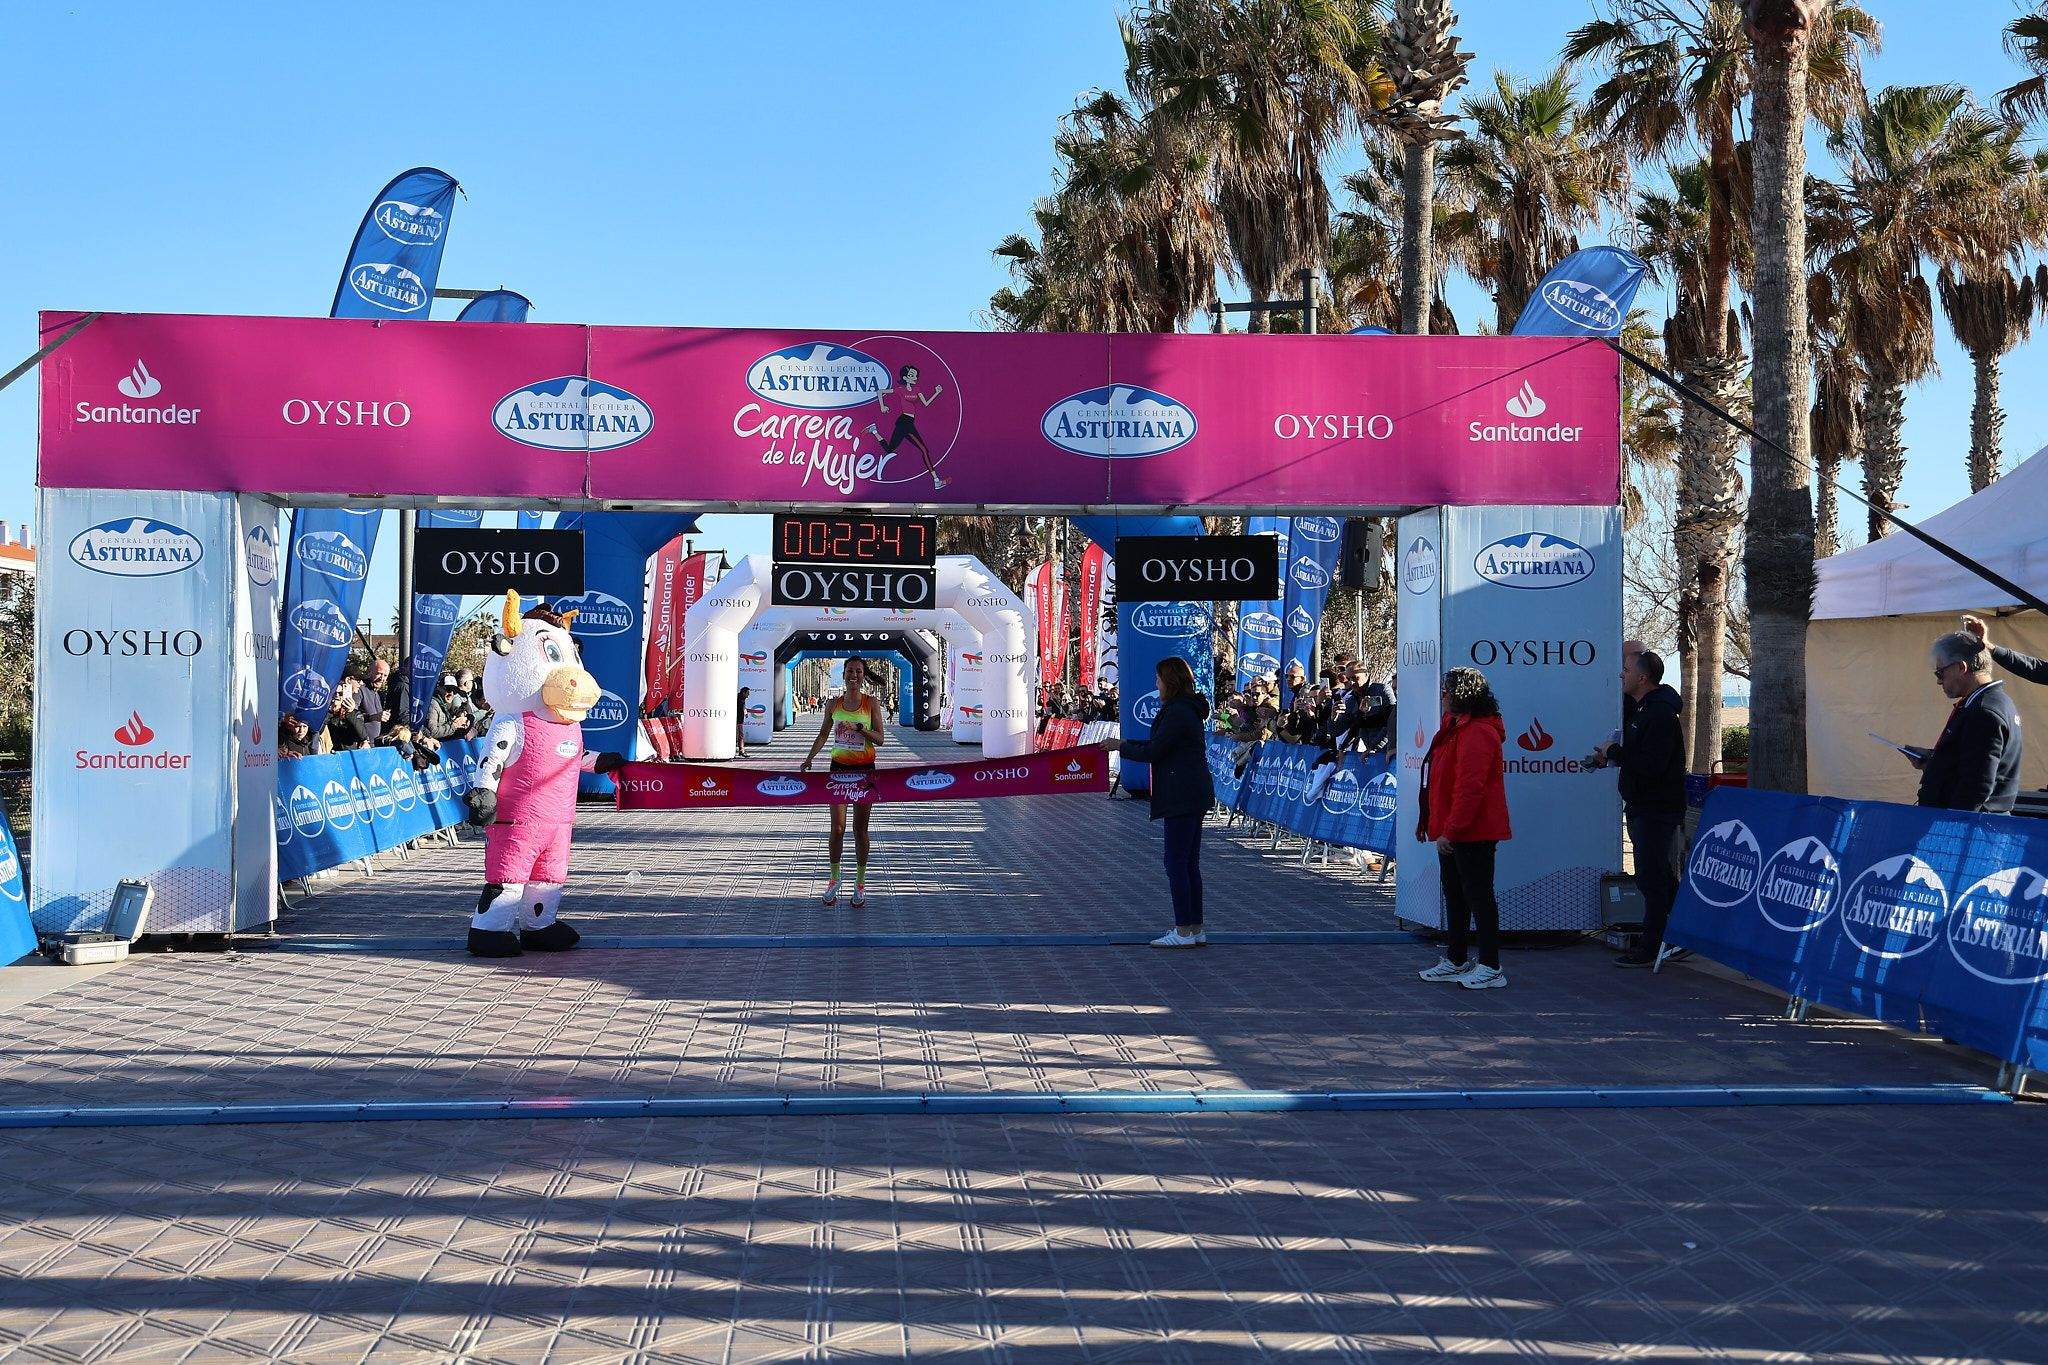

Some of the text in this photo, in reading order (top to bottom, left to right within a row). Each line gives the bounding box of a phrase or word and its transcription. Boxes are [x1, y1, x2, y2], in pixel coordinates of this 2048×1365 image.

[1546, 286, 1613, 327] ASTURIANA
[757, 365, 880, 392] ASTURIANA
[830, 365, 876, 373] LECHERA
[76, 402, 201, 425] Santander
[282, 399, 412, 428] OYSHO
[505, 402, 642, 432] ASTURIANA
[530, 401, 637, 411] CENTRAL LECHERA
[732, 403, 853, 440] Carrera
[1053, 411, 1185, 439] ASTURIANA
[1274, 413, 1394, 440] OYSHO
[1469, 421, 1583, 443] Santander
[762, 437, 898, 495] de la Mujer
[79, 538, 194, 562] ASTURIANA
[784, 521, 925, 557] 00:22:47
[441, 550, 560, 575] OYSHO
[1142, 558, 1255, 583] OYSHO
[1482, 553, 1587, 576] ASTURIANA
[658, 558, 675, 632] Santander
[780, 570, 928, 604] OYSHO
[709, 598, 751, 609] OYSHO
[967, 597, 1008, 607] OYSHO
[63, 629, 203, 657] OYSHO
[808, 633, 889, 641] VOLVO
[690, 652, 729, 662] OYSHO
[990, 654, 1028, 664] OYSHO
[1402, 639, 1436, 667] OYSHO
[1470, 639, 1596, 666] OYSHO
[75, 750, 192, 769] Santander
[1502, 756, 1584, 774] antande
[620, 780, 663, 792] YSHO
[909, 776, 953, 786] ASTURIANA
[974, 767, 1029, 781] OYSHO
[1054, 771, 1094, 781] Santander
[689, 788, 729, 797] Santander
[760, 783, 804, 791] ASTURIANA
[1692, 843, 1753, 892] ASTURIANA
[1760, 864, 1831, 914] ASTURIANA
[1846, 884, 1936, 939] ASTURIANA
[1952, 900, 2048, 961] ASTURIAN
